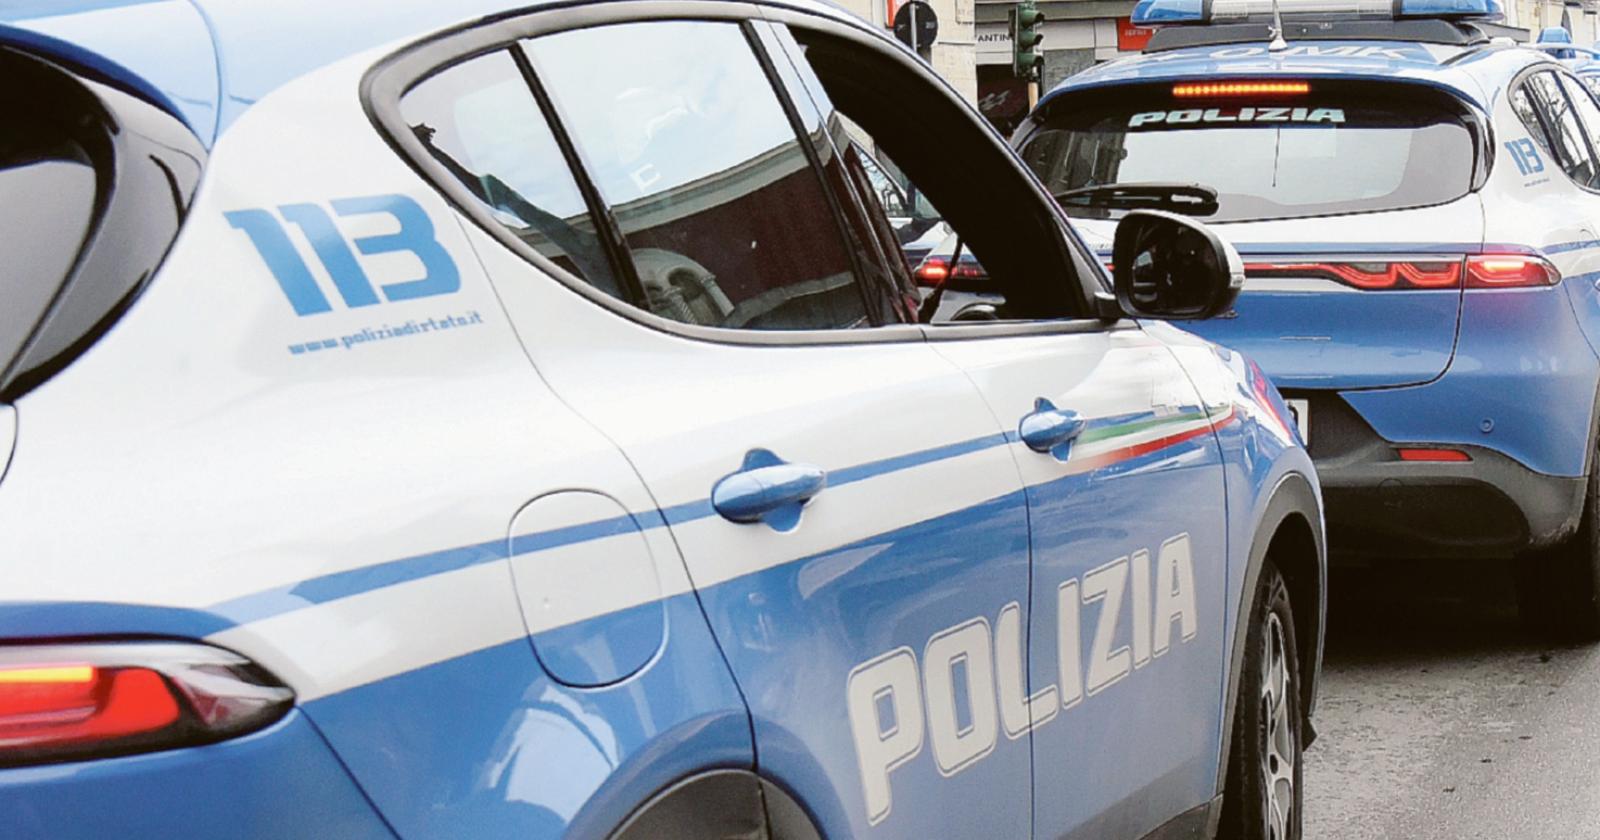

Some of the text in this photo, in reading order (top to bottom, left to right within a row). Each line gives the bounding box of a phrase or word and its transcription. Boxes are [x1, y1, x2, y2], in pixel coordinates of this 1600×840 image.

[1128, 107, 1346, 128] POLIZIA
[1503, 137, 1545, 176] 113
[223, 193, 462, 317] 113
[846, 531, 1199, 827] POLIZIA
